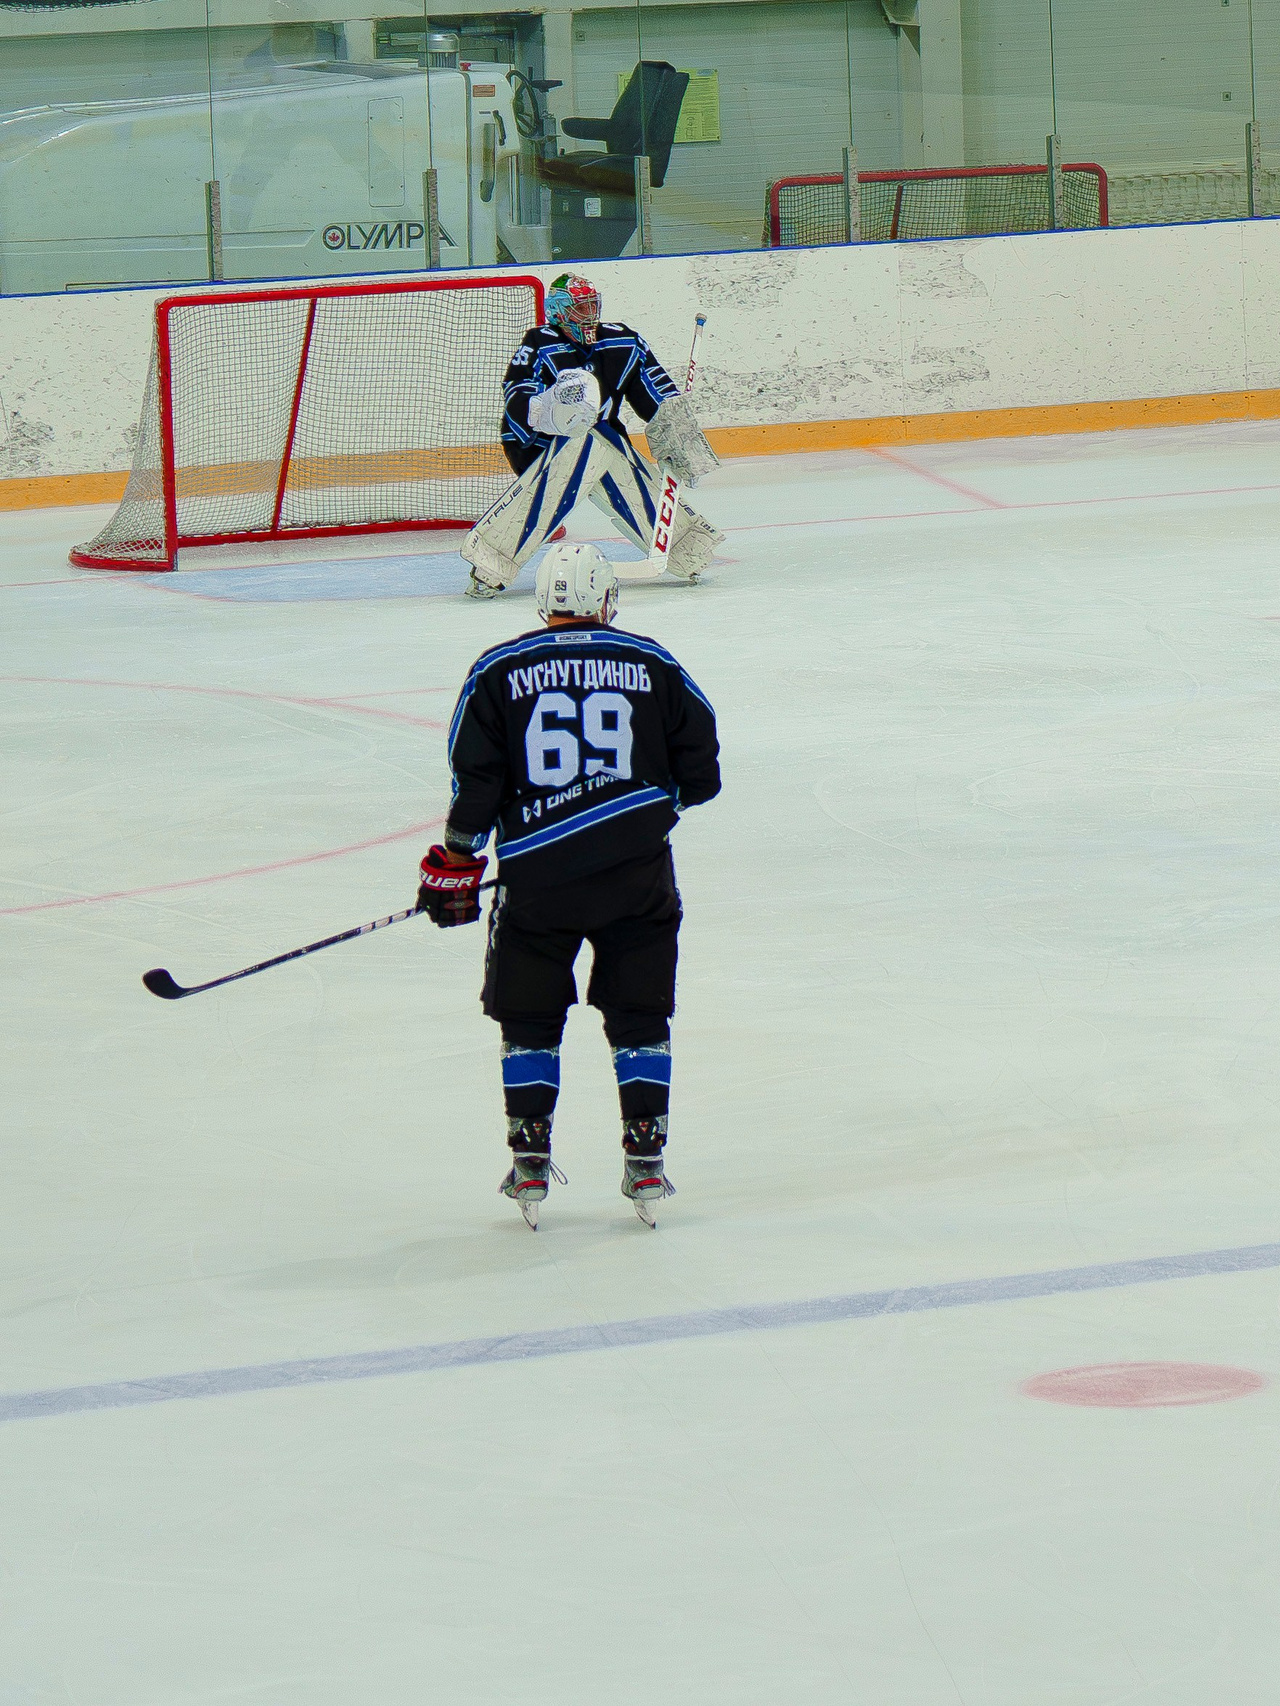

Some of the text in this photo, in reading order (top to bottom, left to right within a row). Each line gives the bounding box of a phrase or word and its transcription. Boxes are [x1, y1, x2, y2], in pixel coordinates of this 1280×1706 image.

[322, 222, 457, 250] OLYMPA
[482, 484, 523, 526] TRUE
[654, 475, 678, 553] CCM
[555, 580, 567, 591] 69
[508, 660, 651, 699] ХУСНУТДИНОВ
[525, 692, 633, 787] 69
[547, 784, 582, 809] ONE
[420, 869, 474, 888] AUER
